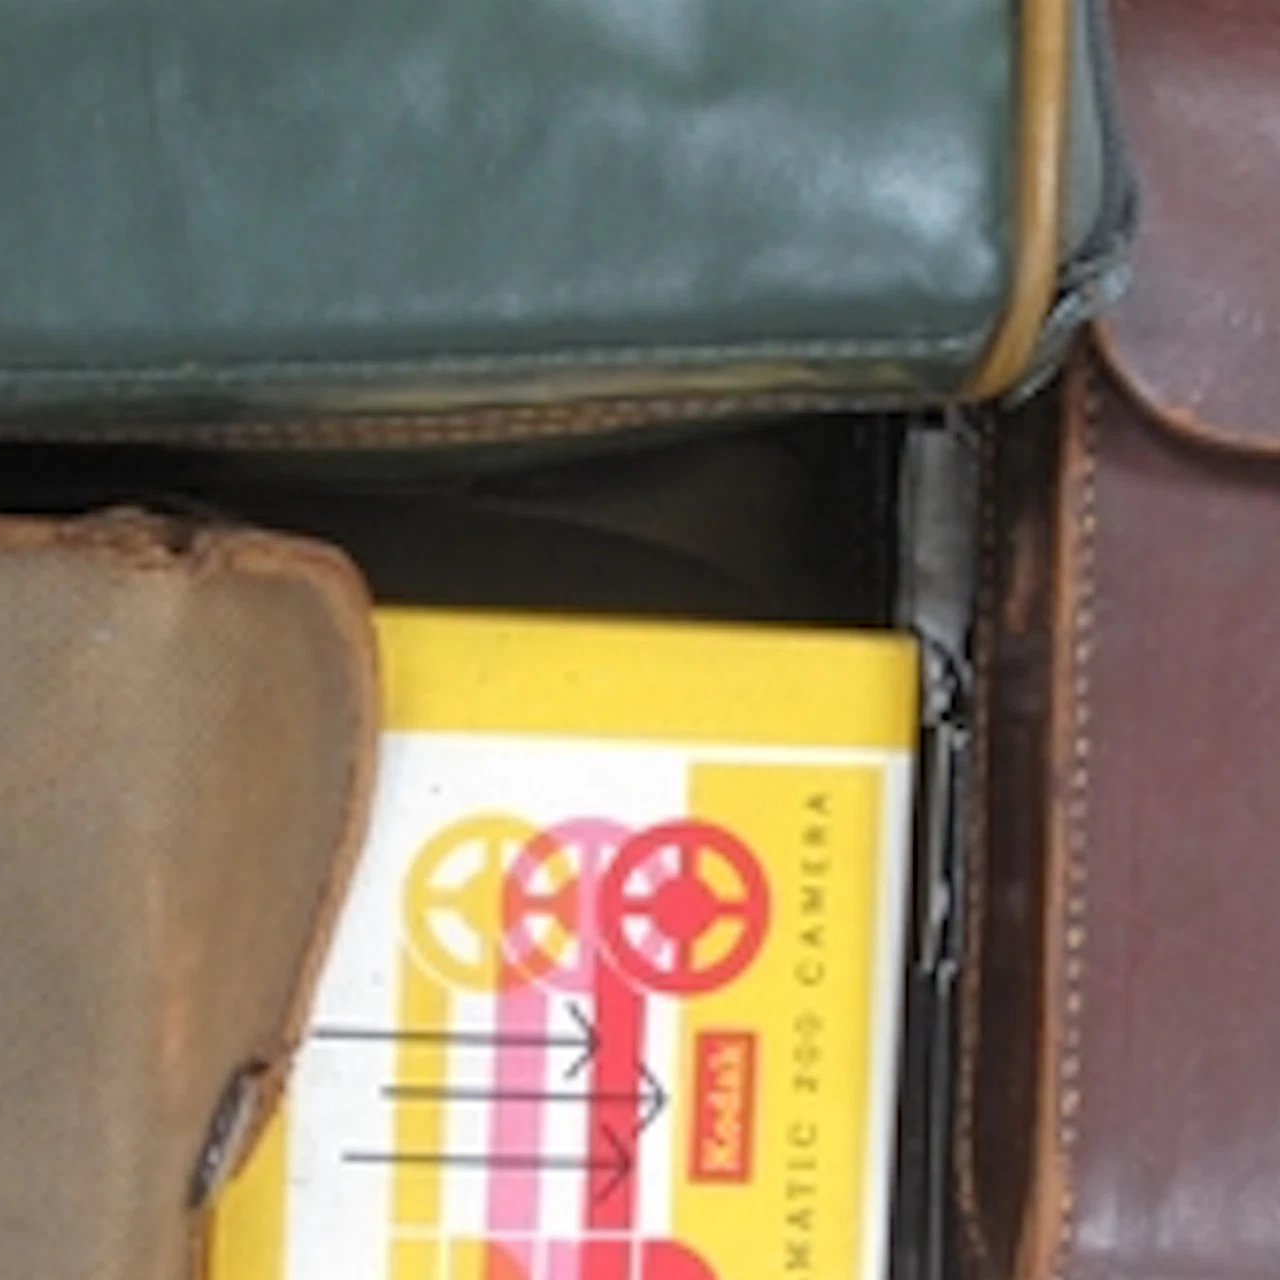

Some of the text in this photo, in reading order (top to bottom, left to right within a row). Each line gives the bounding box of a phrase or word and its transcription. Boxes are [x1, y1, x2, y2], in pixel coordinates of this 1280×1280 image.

[794, 791, 833, 987] CAMERA
[701, 1040, 749, 1176] Kodak
[793, 1014, 824, 1094] 200
